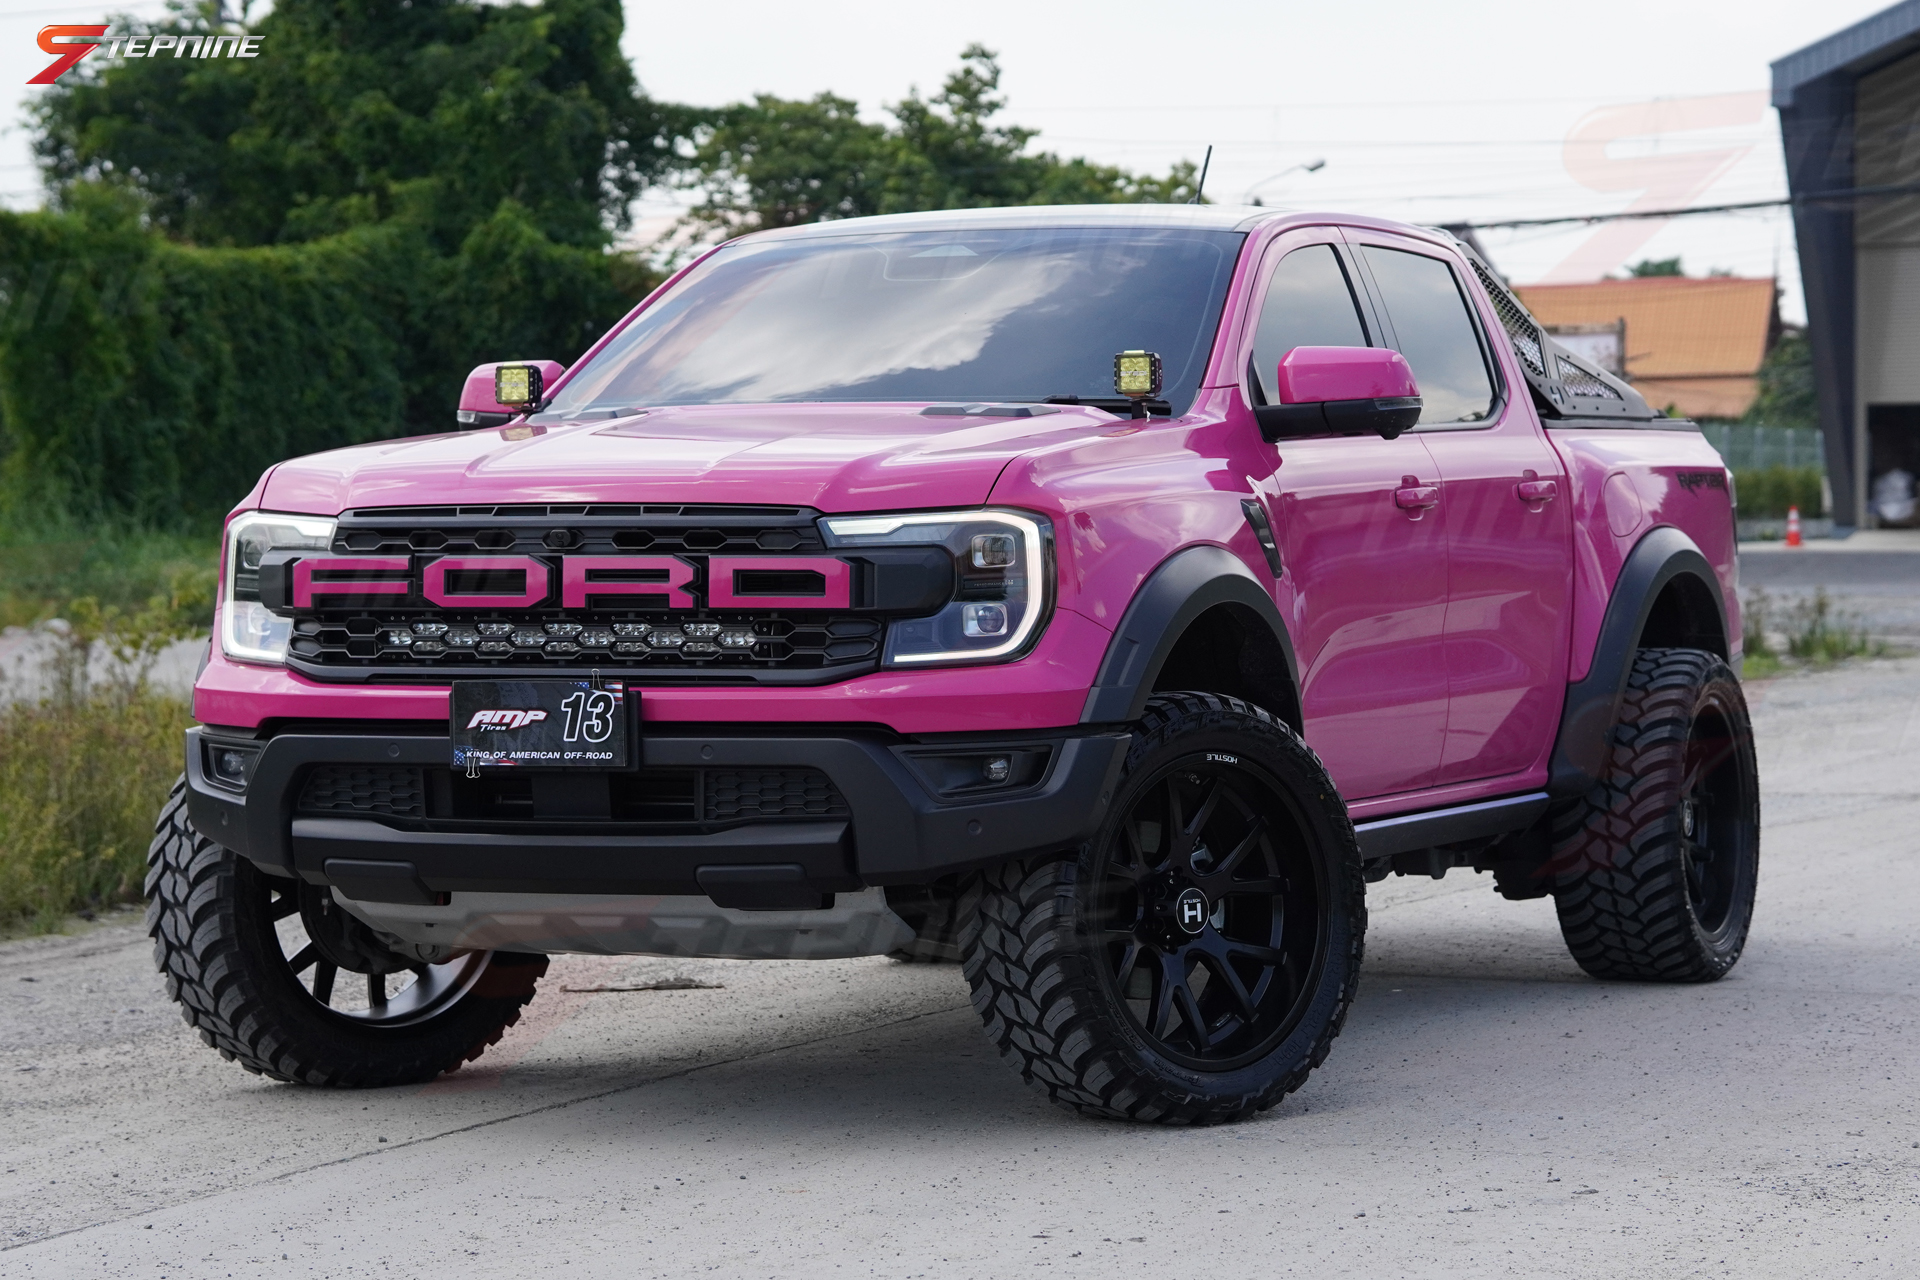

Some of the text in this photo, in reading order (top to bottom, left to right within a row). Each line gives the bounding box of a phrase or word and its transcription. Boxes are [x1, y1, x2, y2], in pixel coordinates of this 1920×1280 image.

[292, 555, 852, 608] FORD
[466, 709, 548, 730] AMP
[561, 691, 615, 743] 13
[466, 751, 613, 760] KING OF AMERICAN OFF-ROAD
[1206, 753, 1237, 764] HOSTILE
[1183, 904, 1202, 923] H
